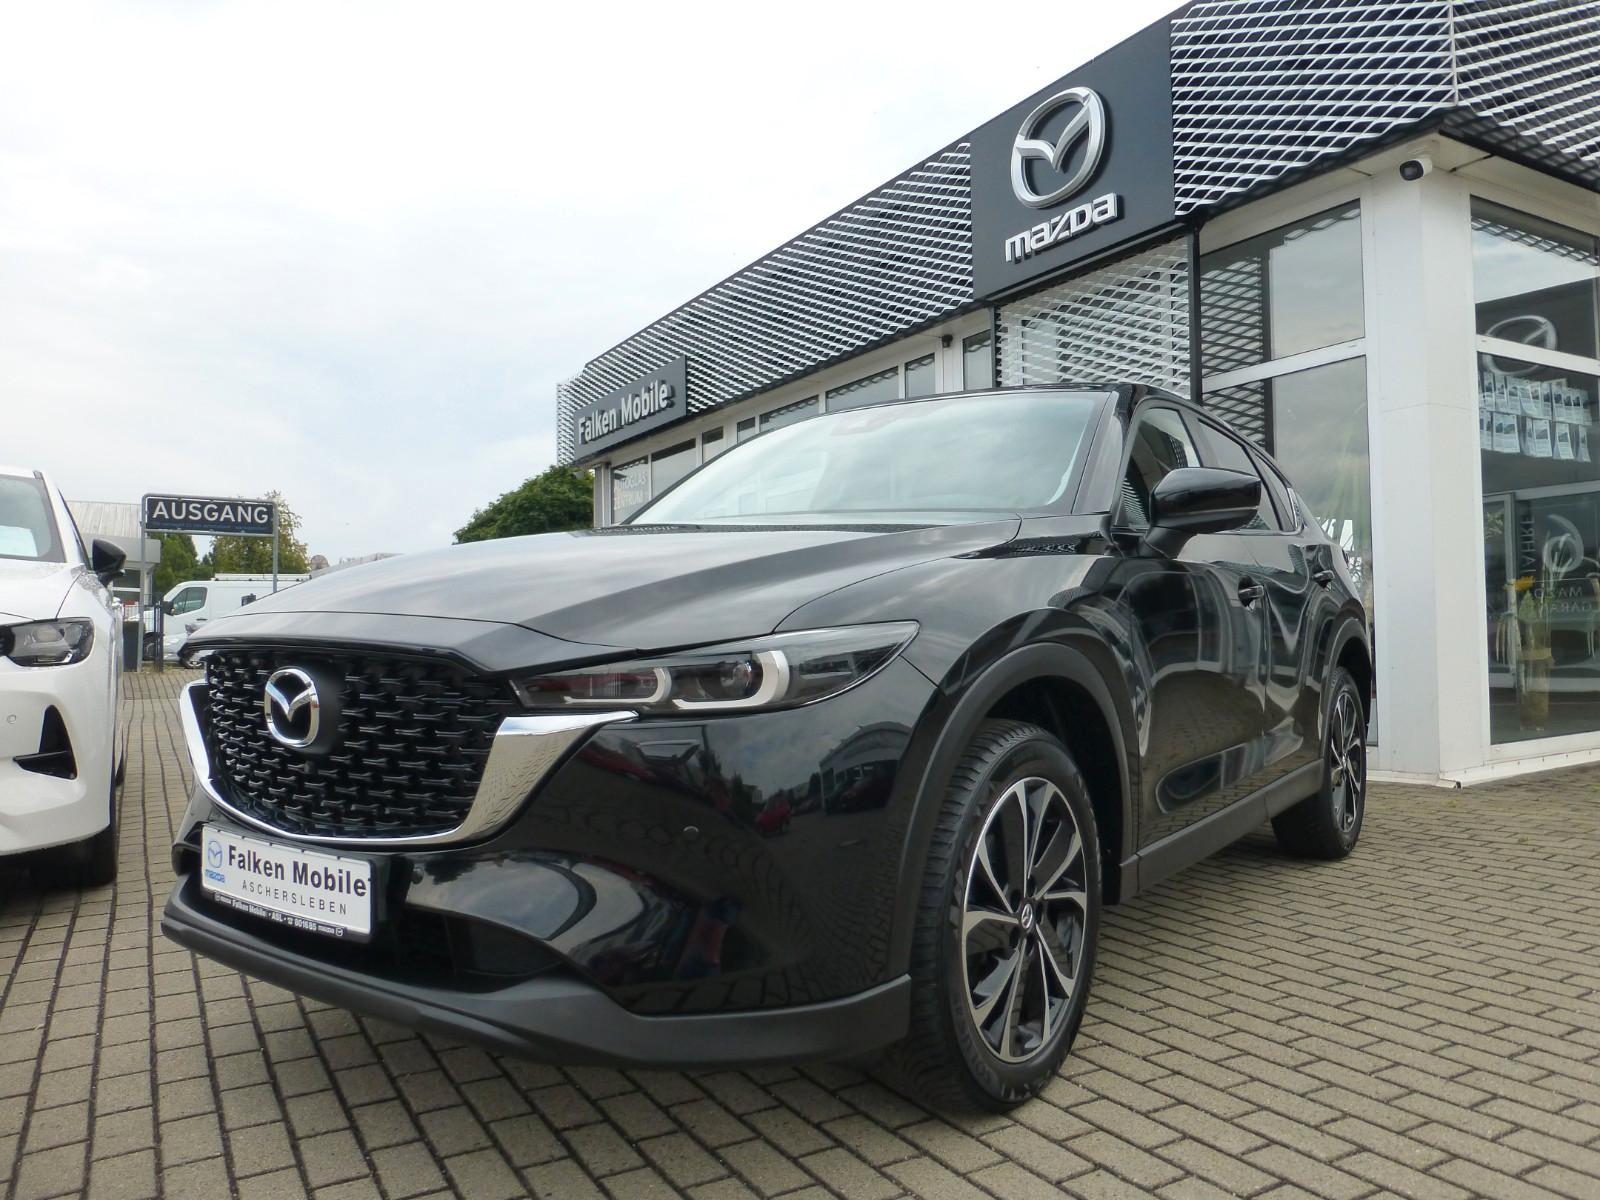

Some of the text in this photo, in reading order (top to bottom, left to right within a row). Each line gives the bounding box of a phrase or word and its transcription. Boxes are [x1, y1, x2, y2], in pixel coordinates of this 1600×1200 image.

[578, 380, 669, 445] Falken Mobile
[152, 501, 269, 524] AUSGANG
[228, 845, 367, 897] Falken Mobile
[242, 880, 347, 915] ASCHERSLEBEN
